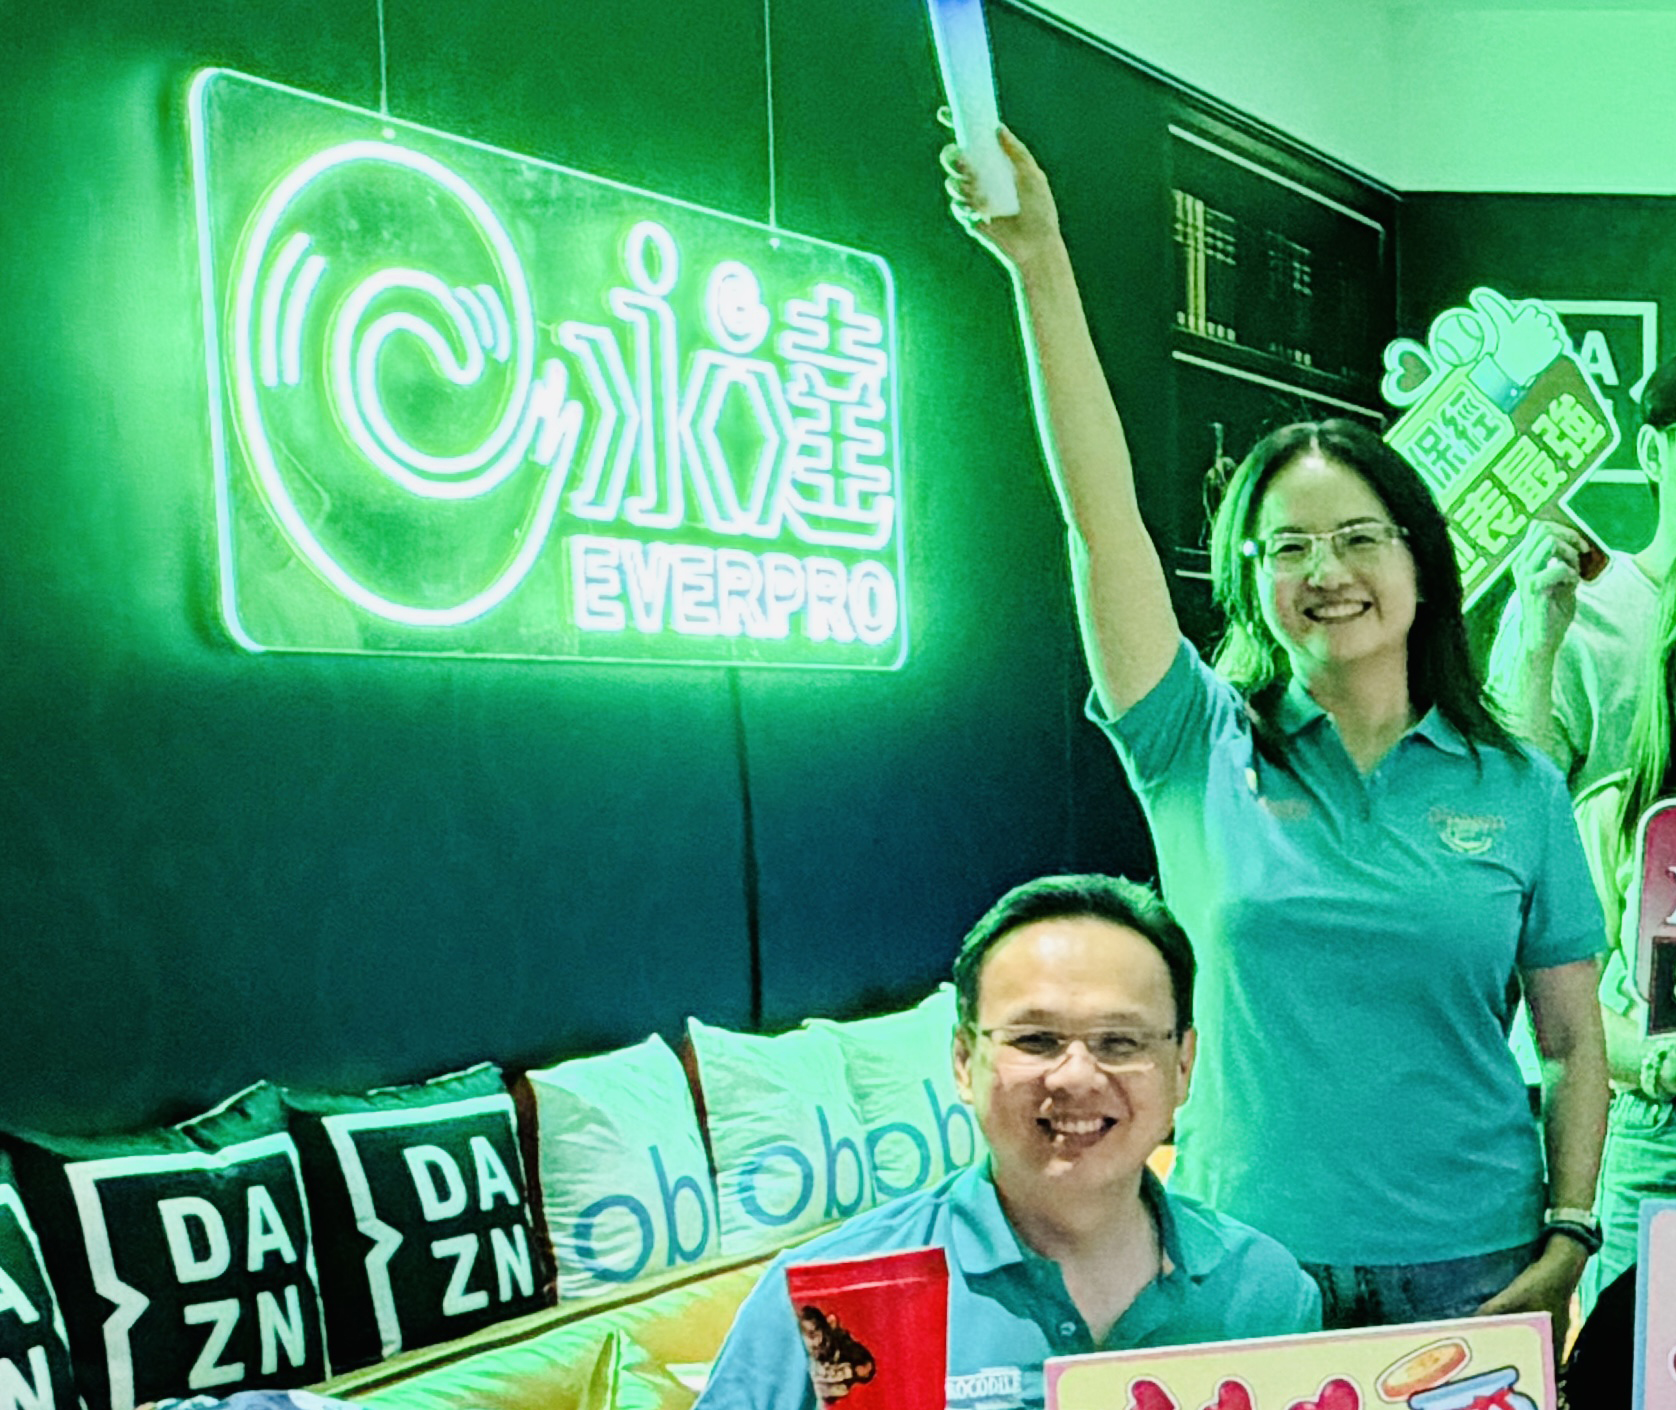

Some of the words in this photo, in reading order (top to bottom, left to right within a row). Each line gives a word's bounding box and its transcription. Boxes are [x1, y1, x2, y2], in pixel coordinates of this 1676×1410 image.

[570, 534, 897, 645] EVERPRO
[405, 1135, 520, 1223] DA
[157, 1185, 298, 1284] DA
[430, 1223, 534, 1317] ZN
[184, 1285, 306, 1390] ZN
